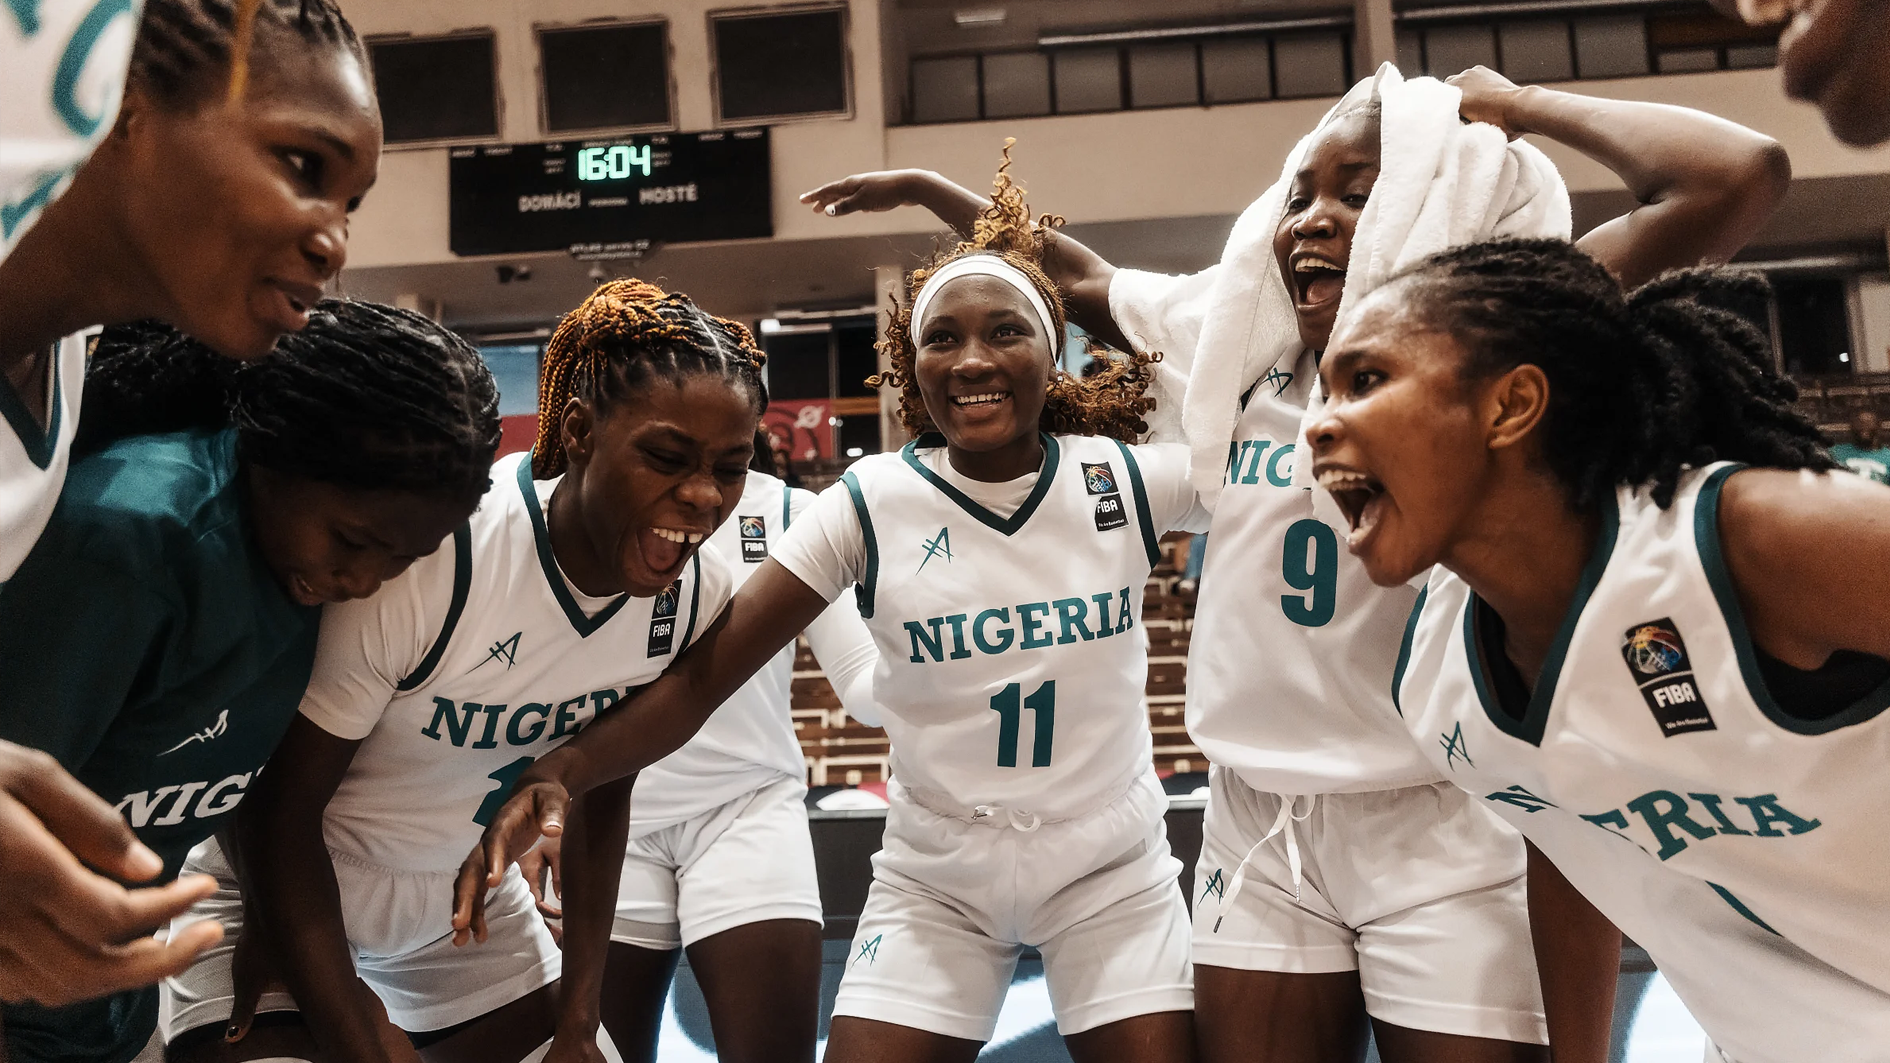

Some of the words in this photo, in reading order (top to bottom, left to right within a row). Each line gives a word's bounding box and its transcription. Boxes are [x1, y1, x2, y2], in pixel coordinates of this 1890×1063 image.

[578, 145, 650, 180] 16:04
[1097, 500, 1118, 513] FIBA
[745, 542, 765, 552] FIBA
[1281, 519, 1338, 627] 9
[652, 623, 671, 638] FIBA
[903, 586, 1134, 663] NIGERIA
[1652, 682, 1697, 708] FIBA
[990, 680, 1056, 768] 11
